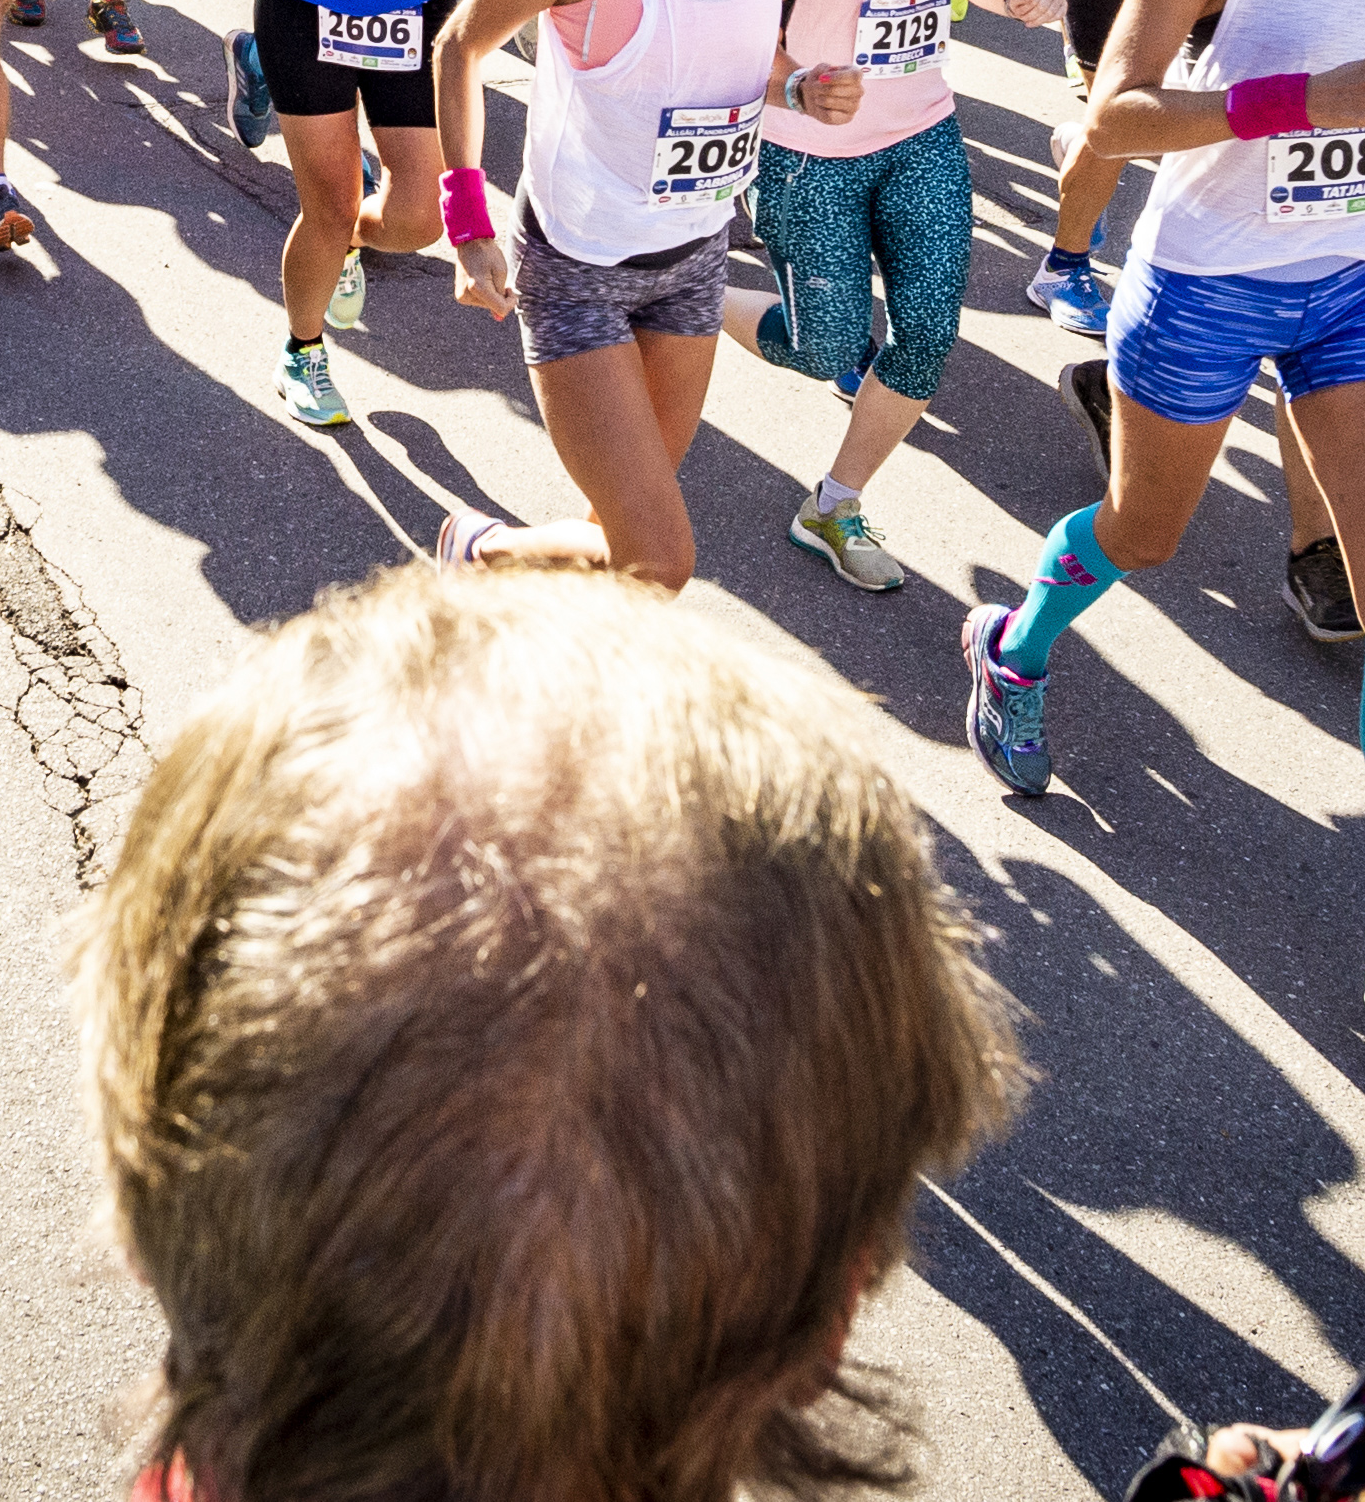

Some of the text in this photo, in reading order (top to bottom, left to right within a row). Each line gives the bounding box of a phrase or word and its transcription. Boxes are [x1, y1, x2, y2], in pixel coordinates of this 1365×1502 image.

[329, 11, 411, 45] 2606
[873, 11, 939, 50] 2129
[888, 48, 924, 63] REBECCA
[694, 169, 744, 190] SABRINA
